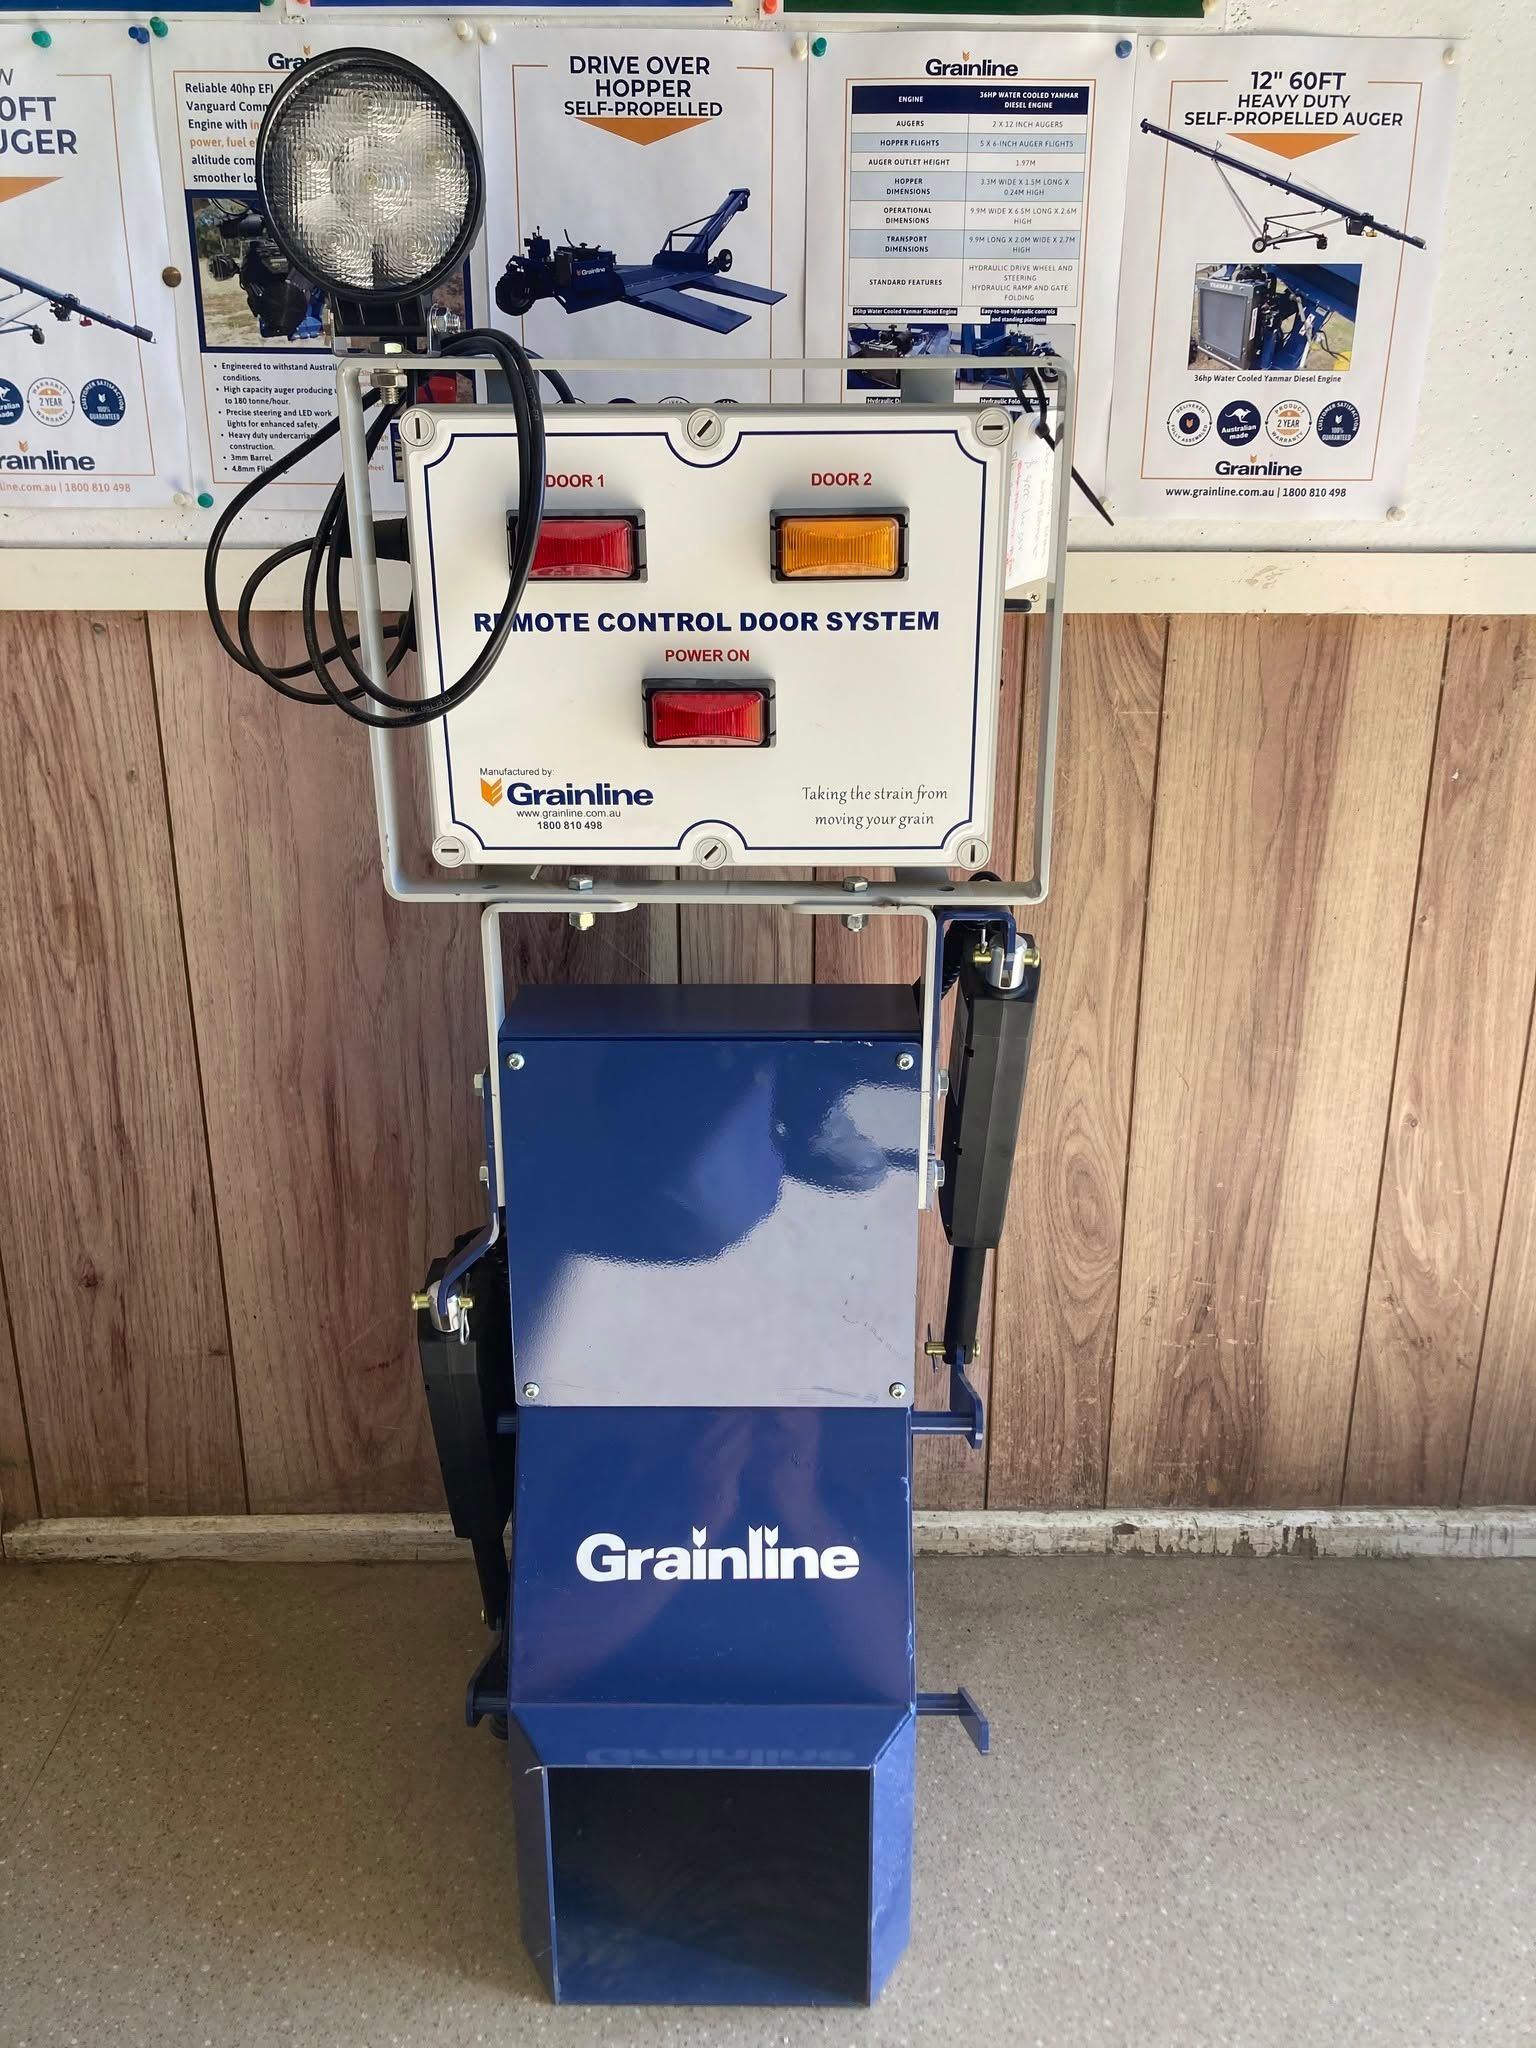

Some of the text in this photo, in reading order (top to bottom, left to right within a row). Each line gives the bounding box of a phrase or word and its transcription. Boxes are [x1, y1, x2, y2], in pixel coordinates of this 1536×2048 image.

[570, 56, 710, 75] DRIVE OVER
[926, 56, 1018, 77] Grainline
[1250, 71, 1346, 90] 12" 60FT
[186, 83, 274, 96] Reliable 40hp EFI
[596, 79, 692, 98] HOPPER
[186, 101, 236, 113] Vanguard
[1238, 94, 1351, 108] HEAVY DUTY
[564, 100, 723, 116] SELF-PROPELLED
[1184, 111, 1404, 126] SELF-PROPELLED AUGER
[188, 120, 222, 131] Engine
[226, 120, 248, 130] with
[190, 138, 224, 149] power,
[227, 137, 246, 148] fuel
[192, 154, 230, 165] altitude
[194, 173, 240, 183] smoother
[222, 362, 262, 371] Engineered
[1194, 374, 1212, 383] 36hp
[1236, 374, 1262, 382] Cooled
[1318, 375, 1342, 384] Engine
[224, 386, 241, 394] High
[242, 386, 272, 395] capacity
[296, 387, 333, 396] producing
[253, 409, 282, 418] steering
[1274, 404, 1305, 414] PRODUCT
[1318, 402, 1358, 432] CUSTOMER SATISFACTION
[227, 420, 247, 428] lights
[296, 421, 320, 429] safety.
[1221, 424, 1256, 434] Australian
[1277, 420, 1300, 428] 2 YEAR
[1272, 432, 1304, 443] WARRANTY
[1215, 459, 1302, 476] Grainline
[545, 474, 604, 488] DOOR 1
[811, 472, 872, 486] DOOR 2
[66, 483, 88, 492] 1800
[92, 483, 110, 492] 810
[113, 483, 131, 493] 498
[1166, 486, 1346, 498] www.grainline.com.au 1800 810 498
[474, 611, 939, 632] RMOTE CONTROL DOOR SYSTEM
[664, 649, 750, 662] POWER ON
[480, 768, 540, 776] Manufactured
[506, 782, 654, 806] Grainline
[802, 784, 948, 805] Taking the strain from
[516, 809, 621, 818] www.grainline.com.au
[537, 821, 603, 830] 1800 810 498
[815, 812, 934, 830] moving your grain
[575, 1525, 860, 1582] Grainline
